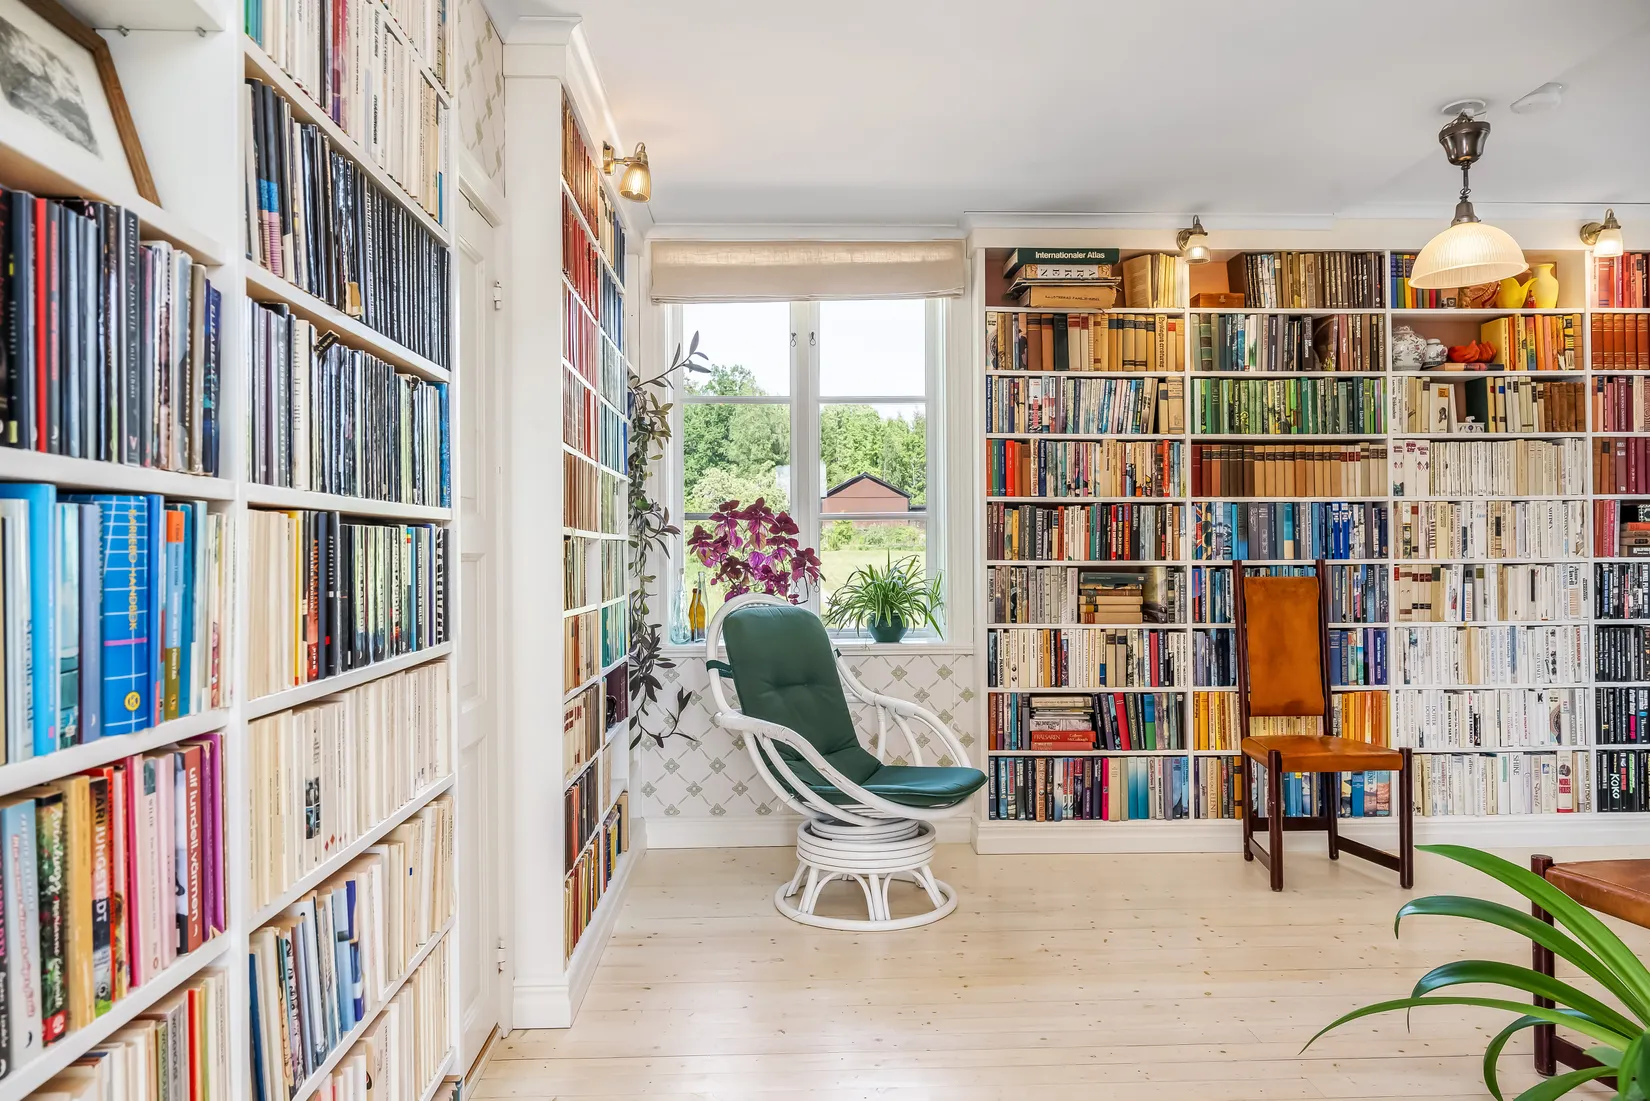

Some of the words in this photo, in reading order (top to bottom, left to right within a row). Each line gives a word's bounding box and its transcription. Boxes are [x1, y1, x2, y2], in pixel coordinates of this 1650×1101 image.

[128, 217, 136, 266] MICHAEL
[1035, 251, 1086, 259] Internationaler
[1087, 251, 1105, 259] Atlas
[129, 509, 137, 563] KARLEBO
[129, 567, 137, 631] HANDBOK
[190, 767, 198, 789] ulf
[1611, 773, 1620, 799] KOKO
[1209, 792, 1217, 813] ELENI
